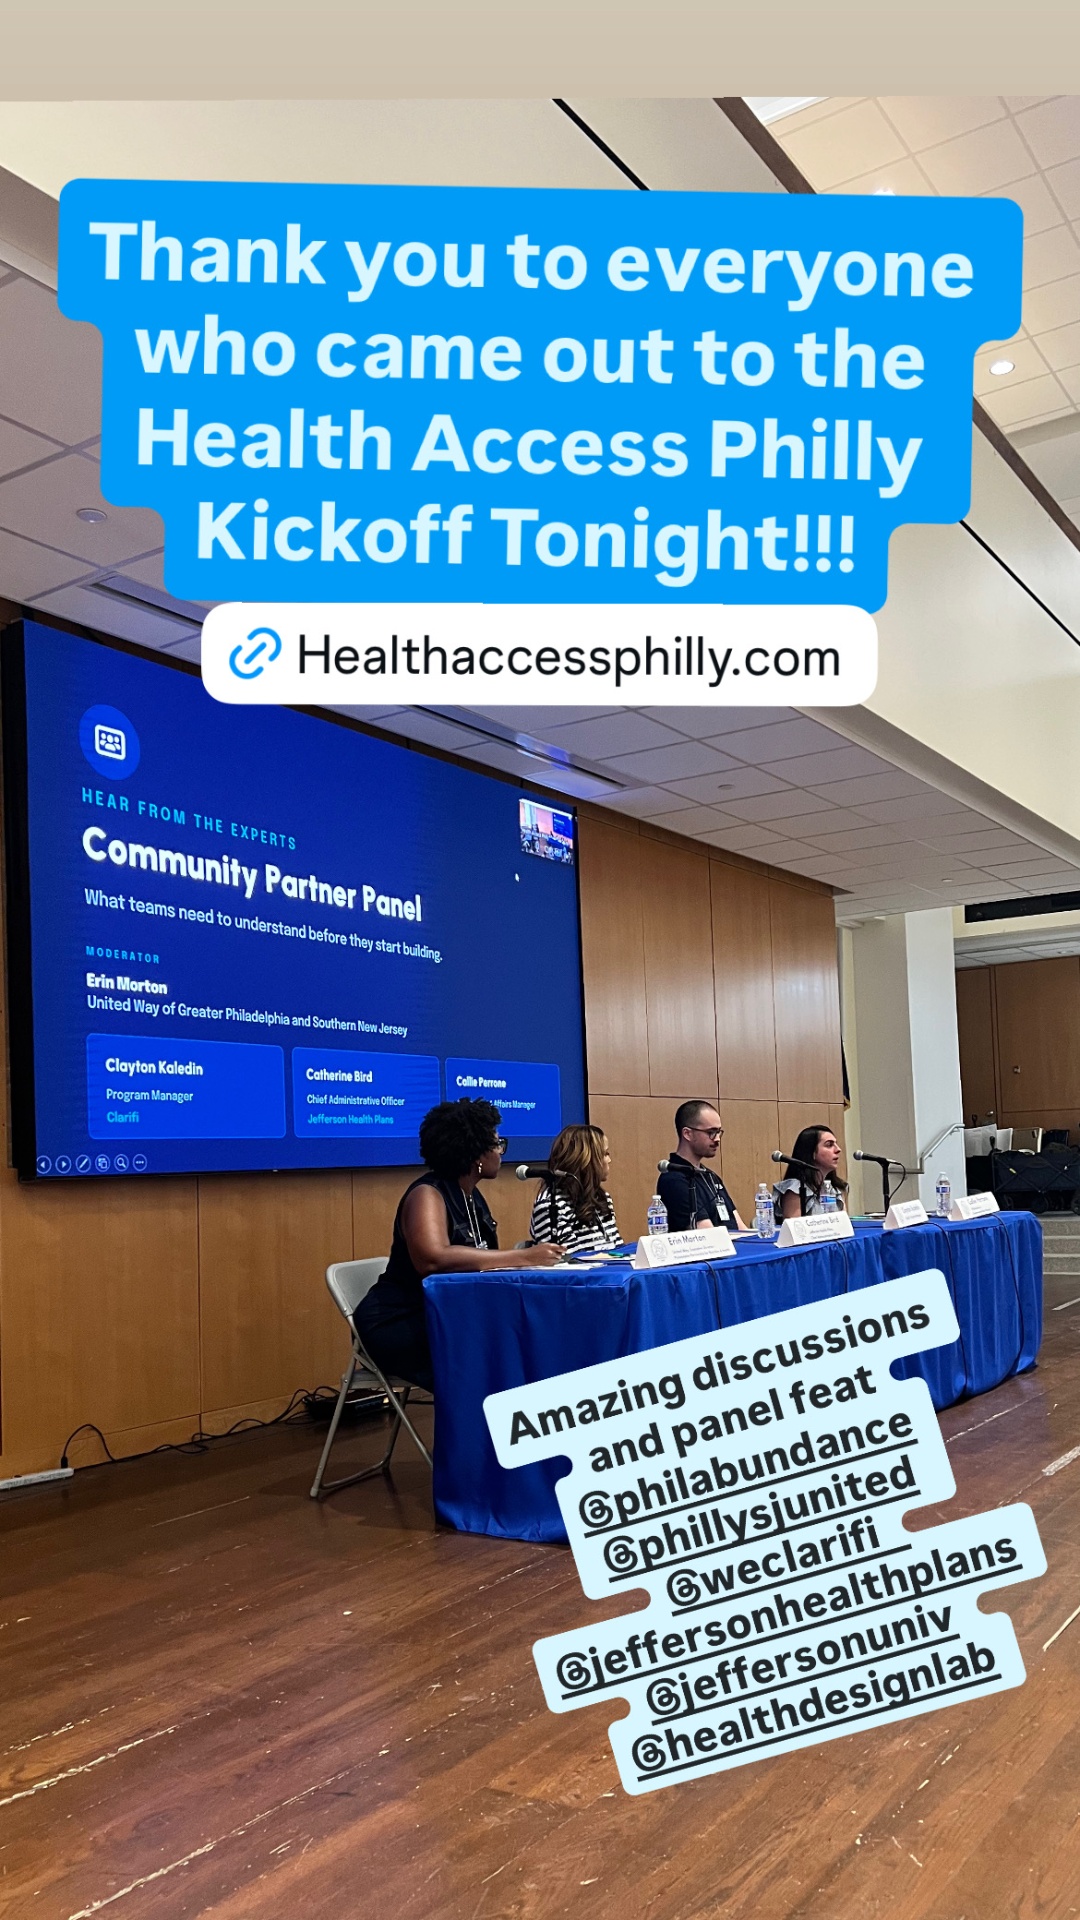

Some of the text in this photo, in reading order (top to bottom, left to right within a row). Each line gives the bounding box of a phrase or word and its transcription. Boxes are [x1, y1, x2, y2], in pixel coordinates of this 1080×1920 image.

[82, 787, 296, 850] HEAR FROM THE EXPERTS
[82, 826, 422, 921] Community Partner Panel
[85, 888, 442, 963] What teams need to understand before they start building.
[86, 946, 159, 964] MODERATOR
[86, 972, 168, 994] Erin Morton
[87, 995, 407, 1038] United Way of Greater Philadelphia and Southern New Jersey
[105, 1058, 203, 1076] Clayton Kaledin
[306, 1068, 372, 1082] Catherine Bird
[106, 1089, 193, 1103] Program Manager
[307, 1094, 404, 1106] Chief Administrative Officer
[107, 1111, 139, 1123] Clarifi
[308, 1114, 394, 1124] Jefferson Health Plans
[668, 1235, 706, 1246] Erin Morton
